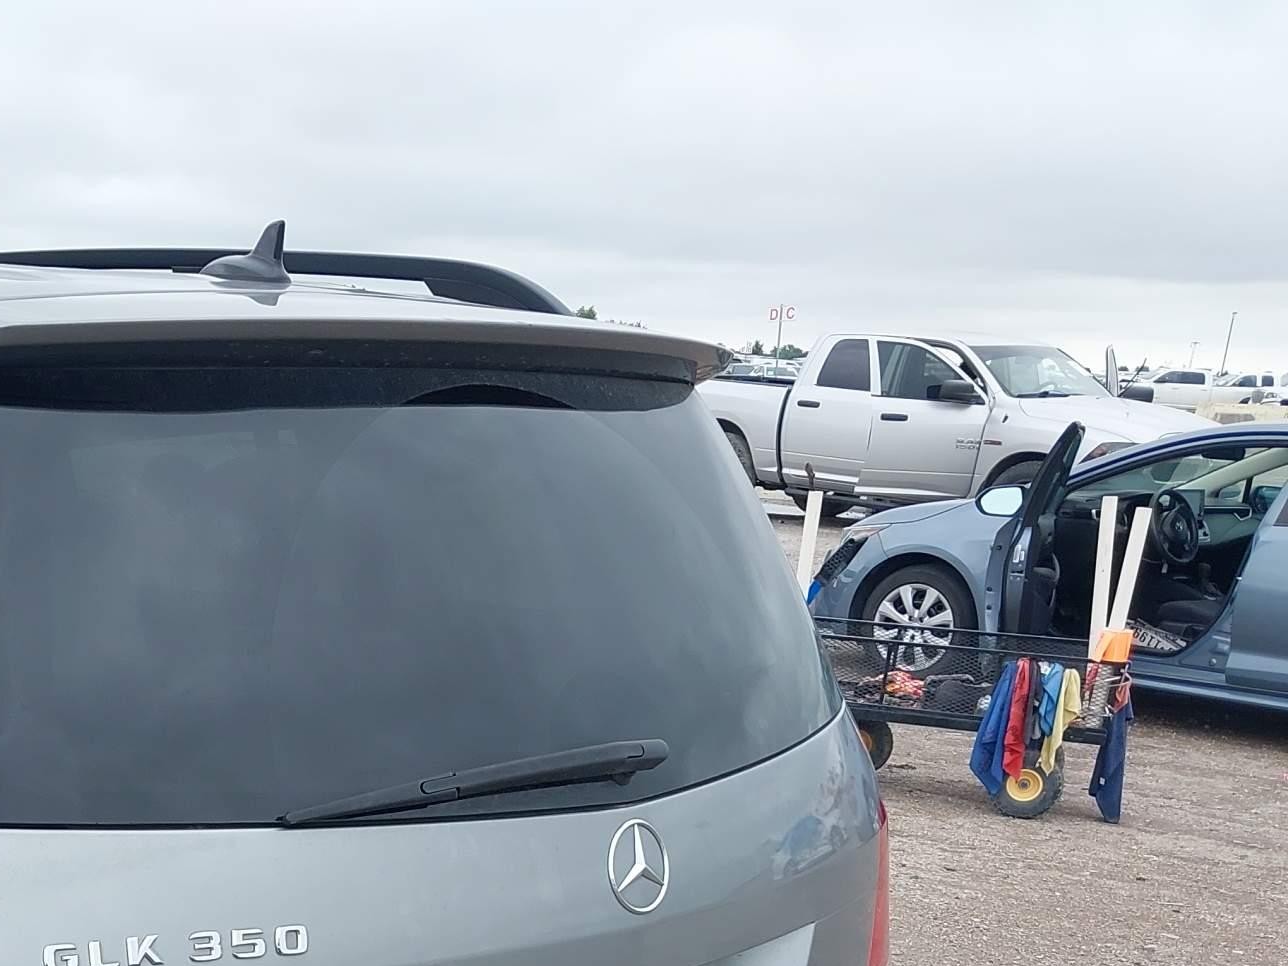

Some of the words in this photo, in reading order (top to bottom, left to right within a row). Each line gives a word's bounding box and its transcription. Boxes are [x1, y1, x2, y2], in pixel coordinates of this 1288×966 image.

[769, 308, 779, 321] D
[786, 306, 796, 320] C
[188, 924, 310, 962] 350
